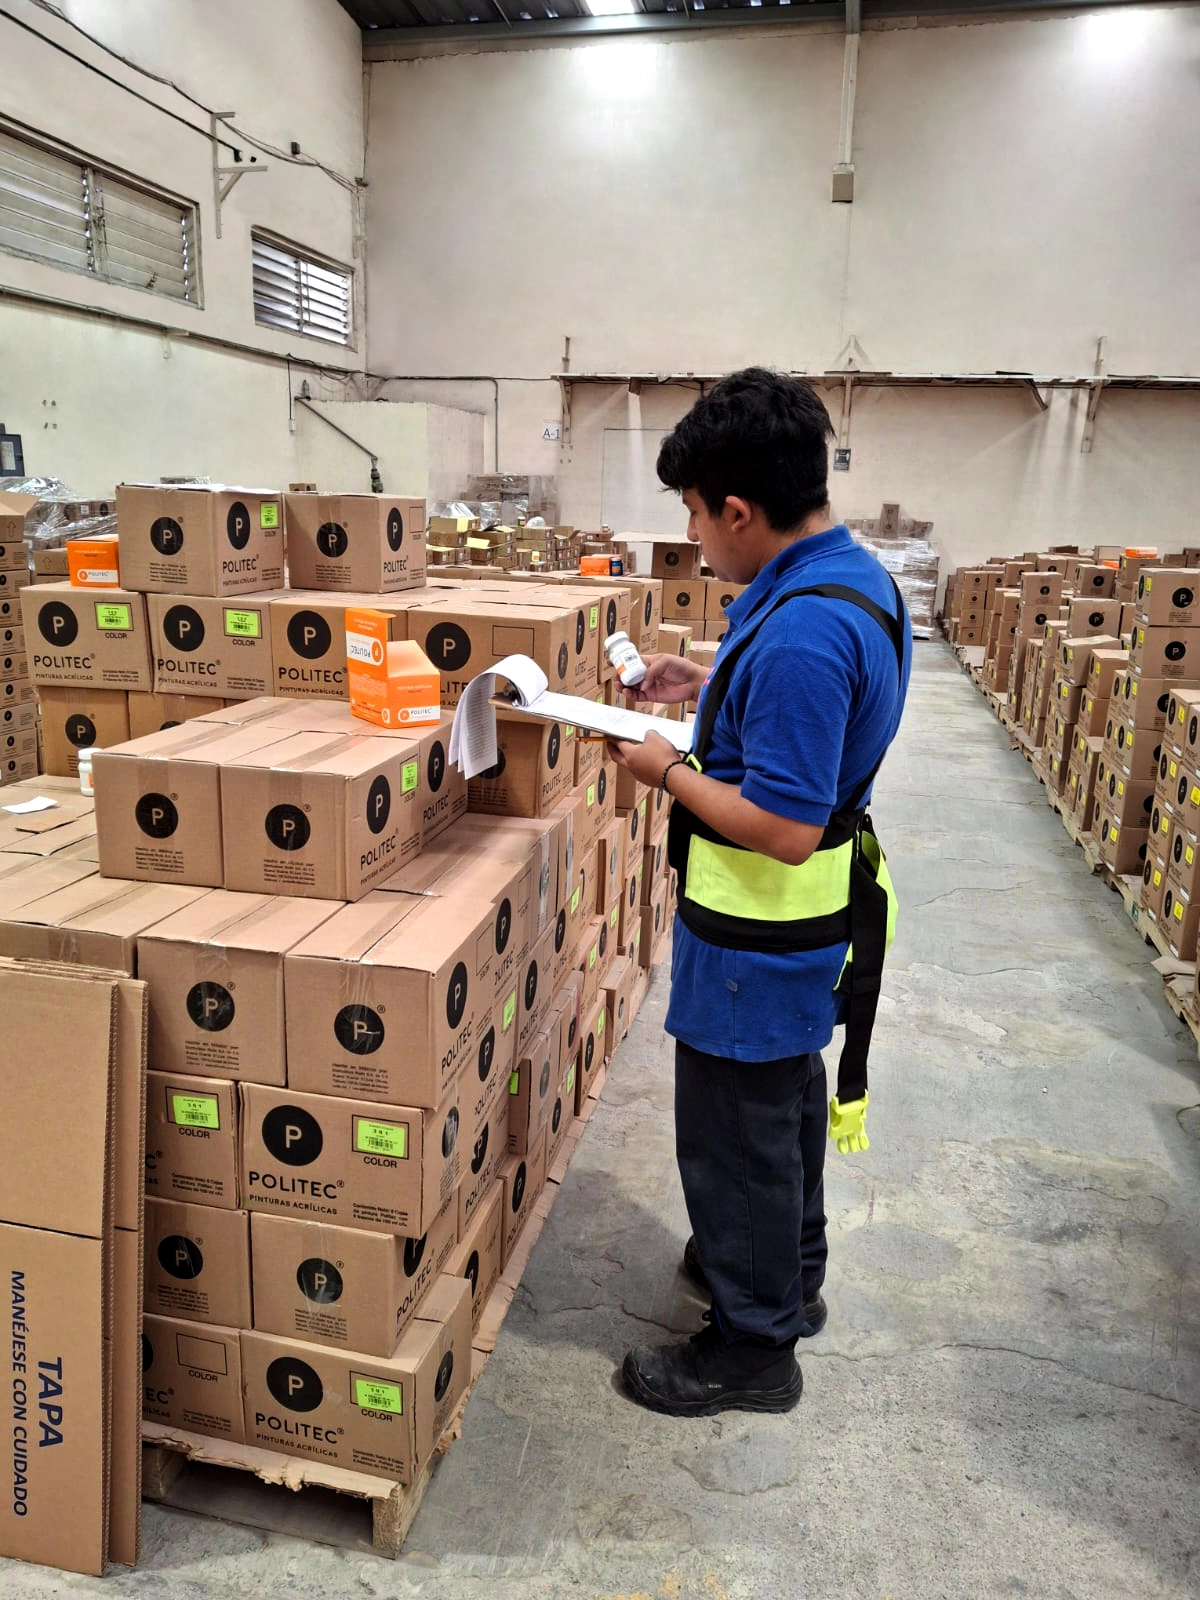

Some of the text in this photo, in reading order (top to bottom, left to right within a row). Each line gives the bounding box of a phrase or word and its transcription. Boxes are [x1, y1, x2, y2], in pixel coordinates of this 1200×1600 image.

[360, 835, 396, 871] POLITEC
[178, 1127, 210, 1139] COLOR
[363, 1156, 397, 1168] COLOR
[249, 1194, 337, 1215] PINTURAS ACRÍLICAS
[397, 1260, 431, 1322] POLITEC
[188, 1369, 218, 1382] COLOR
[11, 1270, 29, 1517] MANÉJESE CON CUIDADO
[38, 1356, 63, 1448] TAPA
[361, 1408, 393, 1422] COLOR
[256, 1433, 338, 1458] PINTURAS ACRÍLICAS
